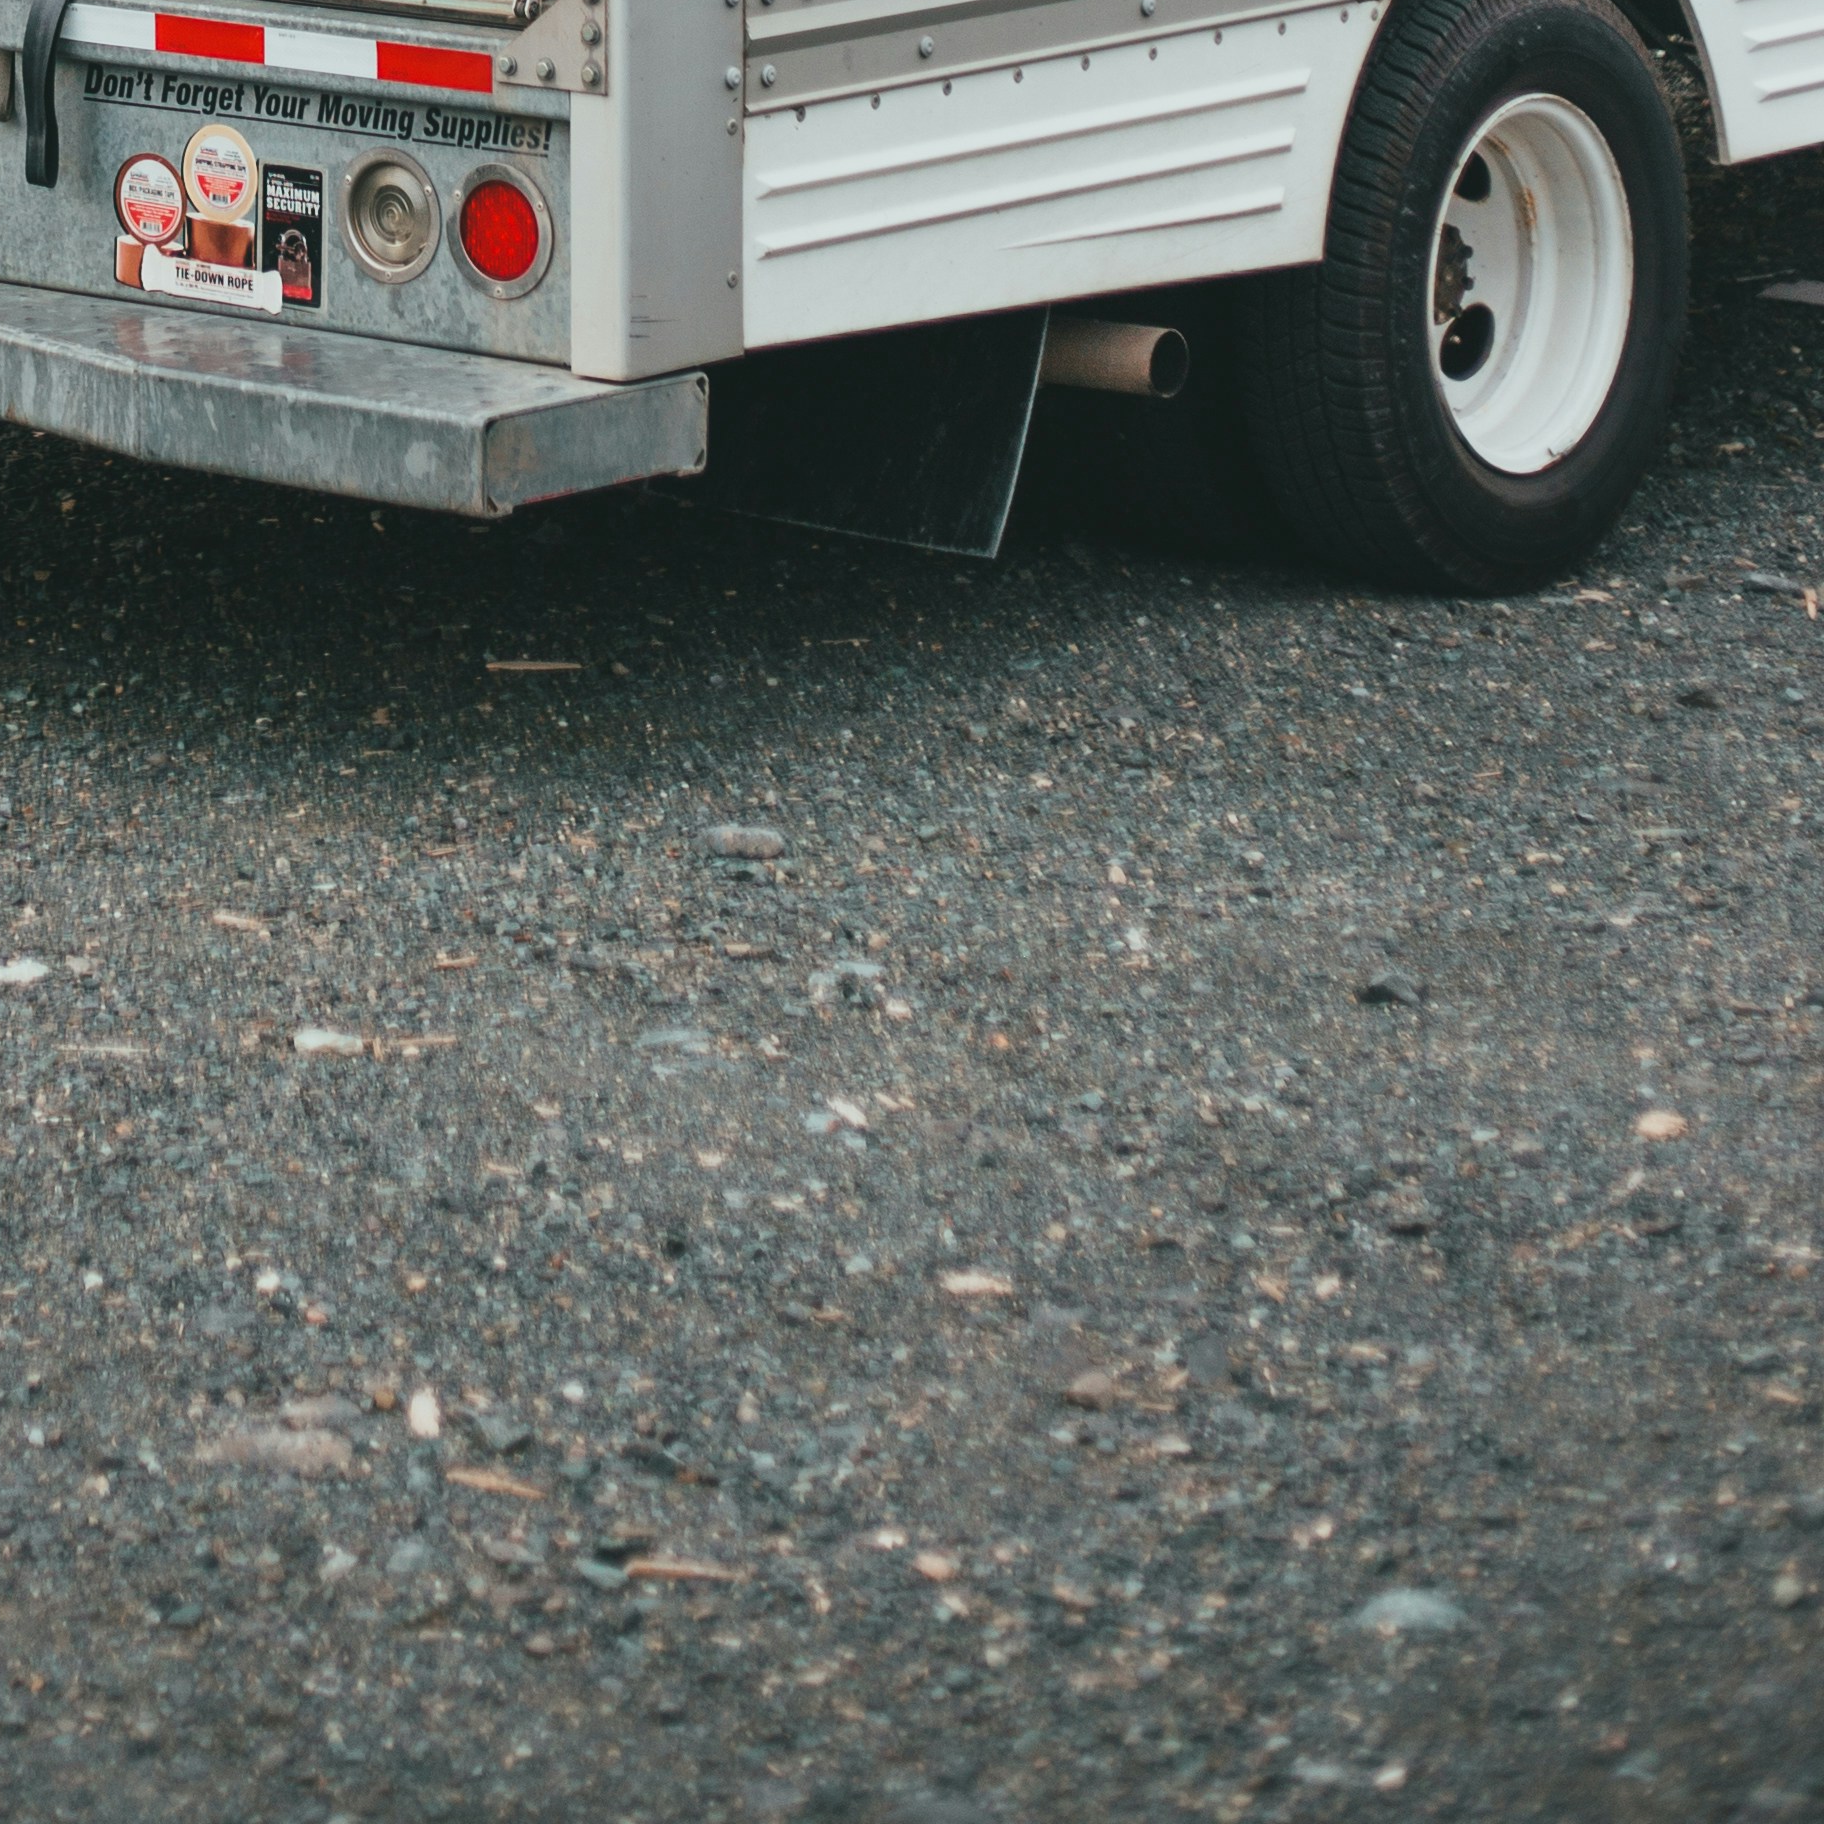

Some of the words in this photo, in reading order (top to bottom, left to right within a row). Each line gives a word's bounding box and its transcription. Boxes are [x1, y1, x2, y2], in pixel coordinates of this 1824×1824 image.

[83, 63, 154, 101] Don't
[161, 74, 245, 116] Forget
[254, 85, 311, 120] Your
[317, 93, 415, 140] Moving
[423, 107, 553, 150] Supplies!
[266, 184, 320, 204] MAXIMUM
[266, 197, 320, 216] SECURITY
[176, 266, 224, 286] TIE-DOWN
[227, 276, 254, 291] ROPE
